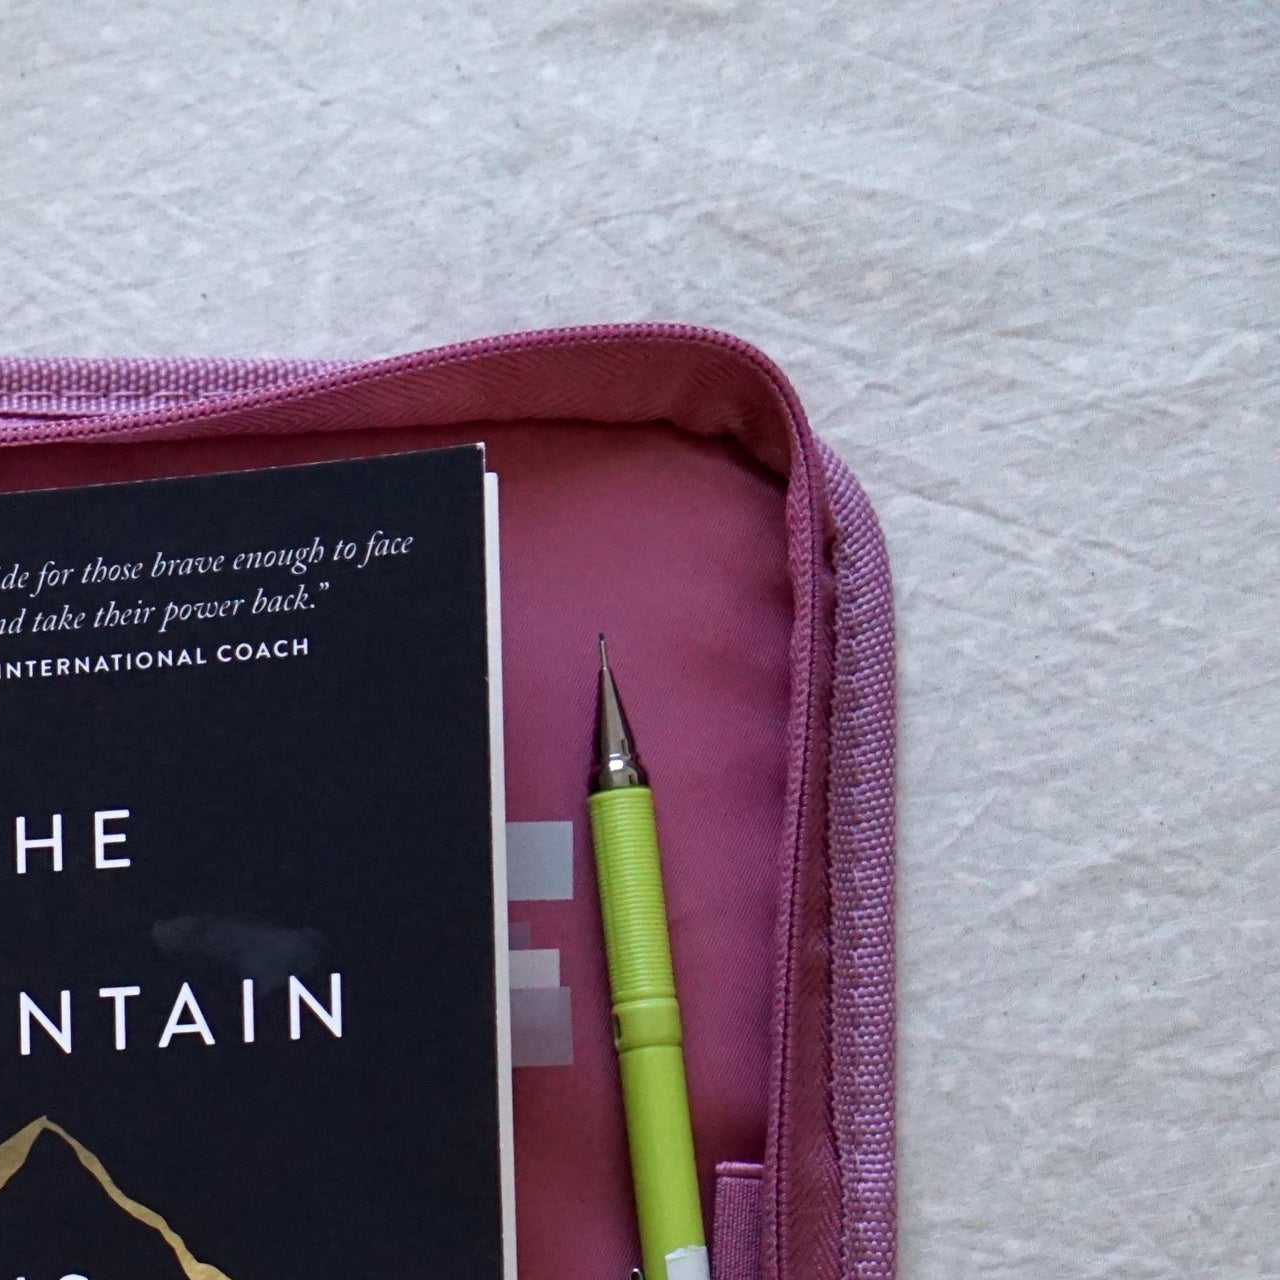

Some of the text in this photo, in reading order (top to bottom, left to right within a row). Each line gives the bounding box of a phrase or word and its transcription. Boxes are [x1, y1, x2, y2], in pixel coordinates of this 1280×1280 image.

[29, 560, 75, 598] for
[81, 556, 144, 584] those
[150, 551, 225, 578] brave
[232, 536, 325, 575] enough
[332, 539, 357, 561] to
[356, 530, 414, 569] face
[31, 604, 86, 633] take
[93, 599, 157, 628] their
[157, 598, 246, 634] power
[251, 581, 330, 615] back.”
[216, 637, 309, 663] COACH
